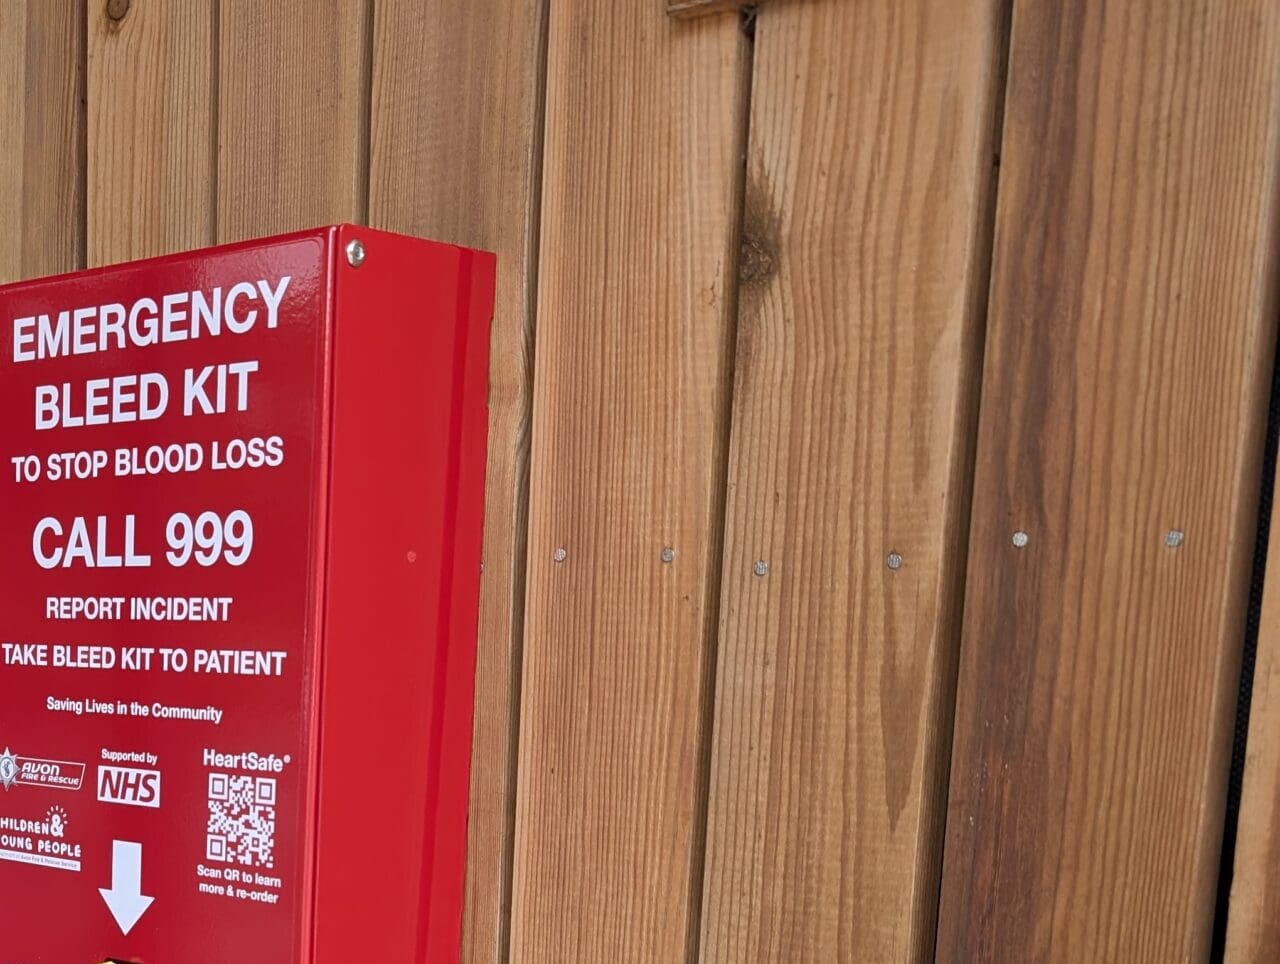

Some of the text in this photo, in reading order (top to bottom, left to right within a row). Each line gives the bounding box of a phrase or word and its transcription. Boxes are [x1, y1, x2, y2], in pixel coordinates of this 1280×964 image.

[13, 276, 291, 362] EMERGENCY
[35, 361, 259, 430] BLEED KIT
[12, 436, 284, 482] TO STOP BLOOD LOSS
[32, 510, 253, 569] CALL 999
[46, 597, 233, 621] REPORT INCIDENT
[2, 644, 287, 675] TAKE BLEED KIT TO PATIENT
[47, 697, 222, 723] Saving Lives in the Community
[22, 763, 60, 775] AVON
[102, 749, 157, 766] Supported by
[21, 772, 38, 781] FIRE
[48, 776, 79, 785] RESCUE
[100, 770, 157, 802] NHS
[38, 840, 81, 857] PEOPLE
[197, 864, 281, 887] Scan QR to learn
[199, 882, 279, 904] more & re-order
